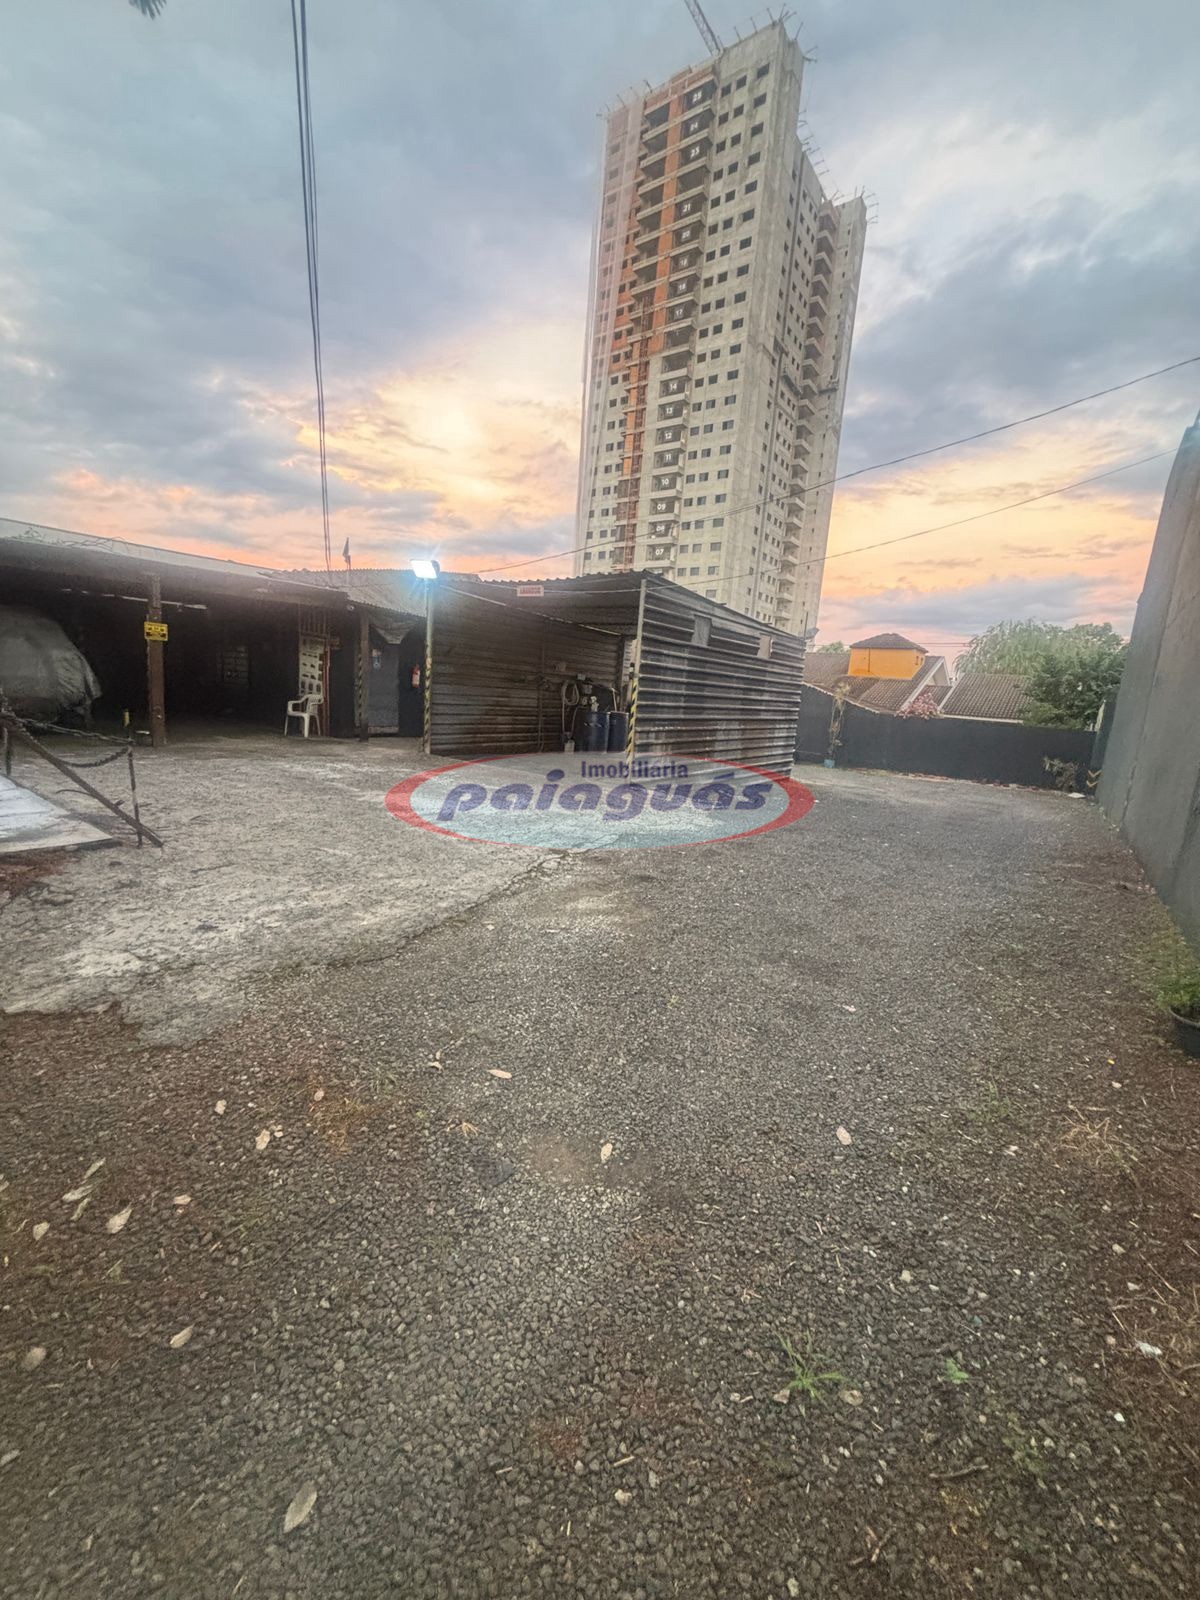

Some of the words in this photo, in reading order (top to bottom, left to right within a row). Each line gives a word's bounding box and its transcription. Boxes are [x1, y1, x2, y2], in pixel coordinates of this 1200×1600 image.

[661, 478, 669, 486] 10
[656, 503, 666, 511] 09
[655, 548, 664, 556] 07
